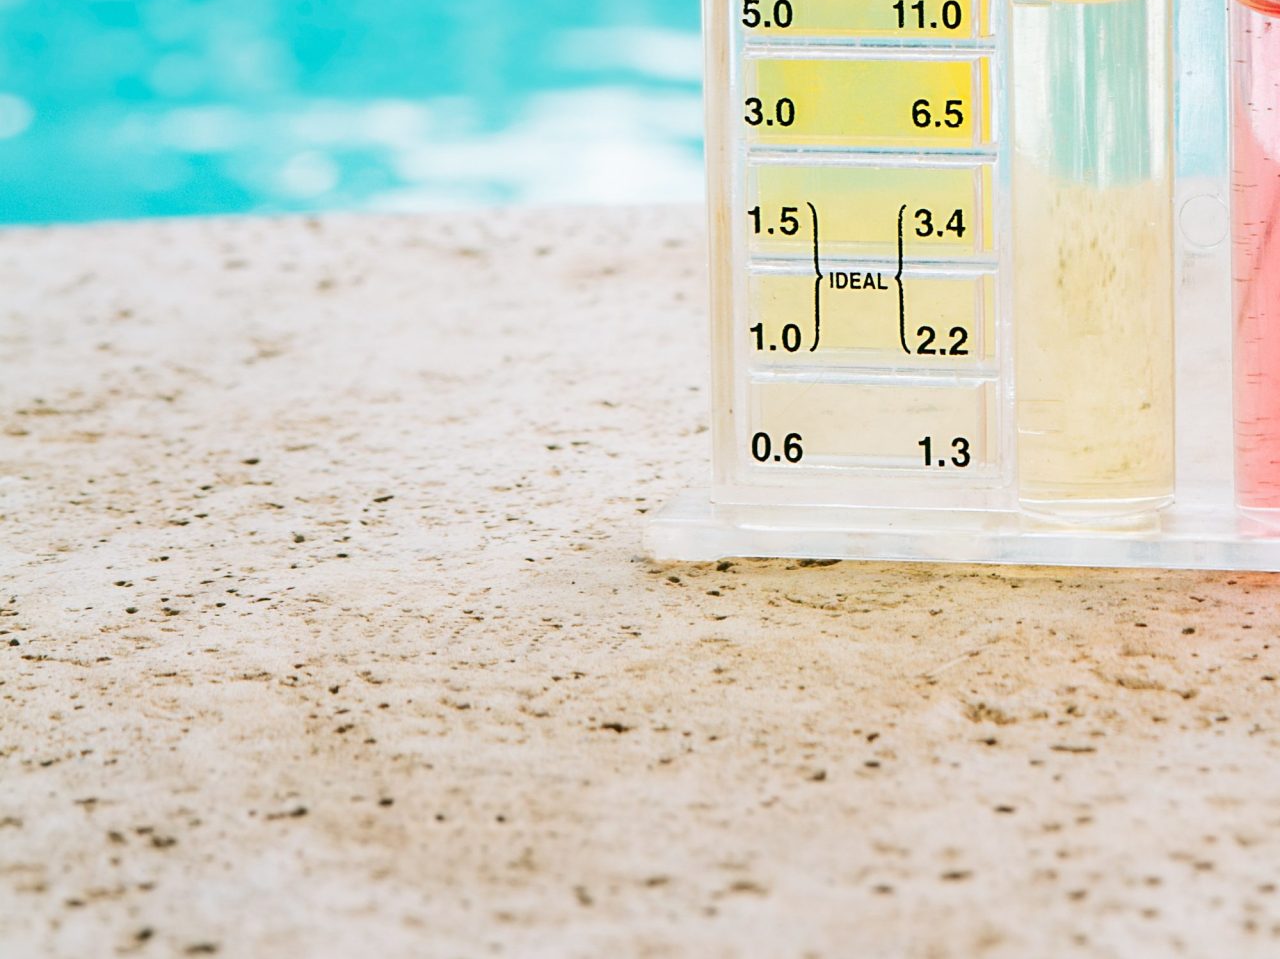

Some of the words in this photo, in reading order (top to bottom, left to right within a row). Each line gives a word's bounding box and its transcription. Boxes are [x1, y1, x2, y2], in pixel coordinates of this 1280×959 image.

[892, 0, 962, 30] 11.0
[744, 97, 796, 127] 3.0
[911, 98, 964, 128] 6.5
[747, 205, 799, 236] 1.5
[914, 208, 966, 238] 3.4
[829, 271, 889, 290] IDEAL
[749, 322, 802, 353] 1.0
[916, 325, 969, 356] 2.2
[751, 431, 804, 464] 0.6
[918, 436, 971, 468] 1.3
